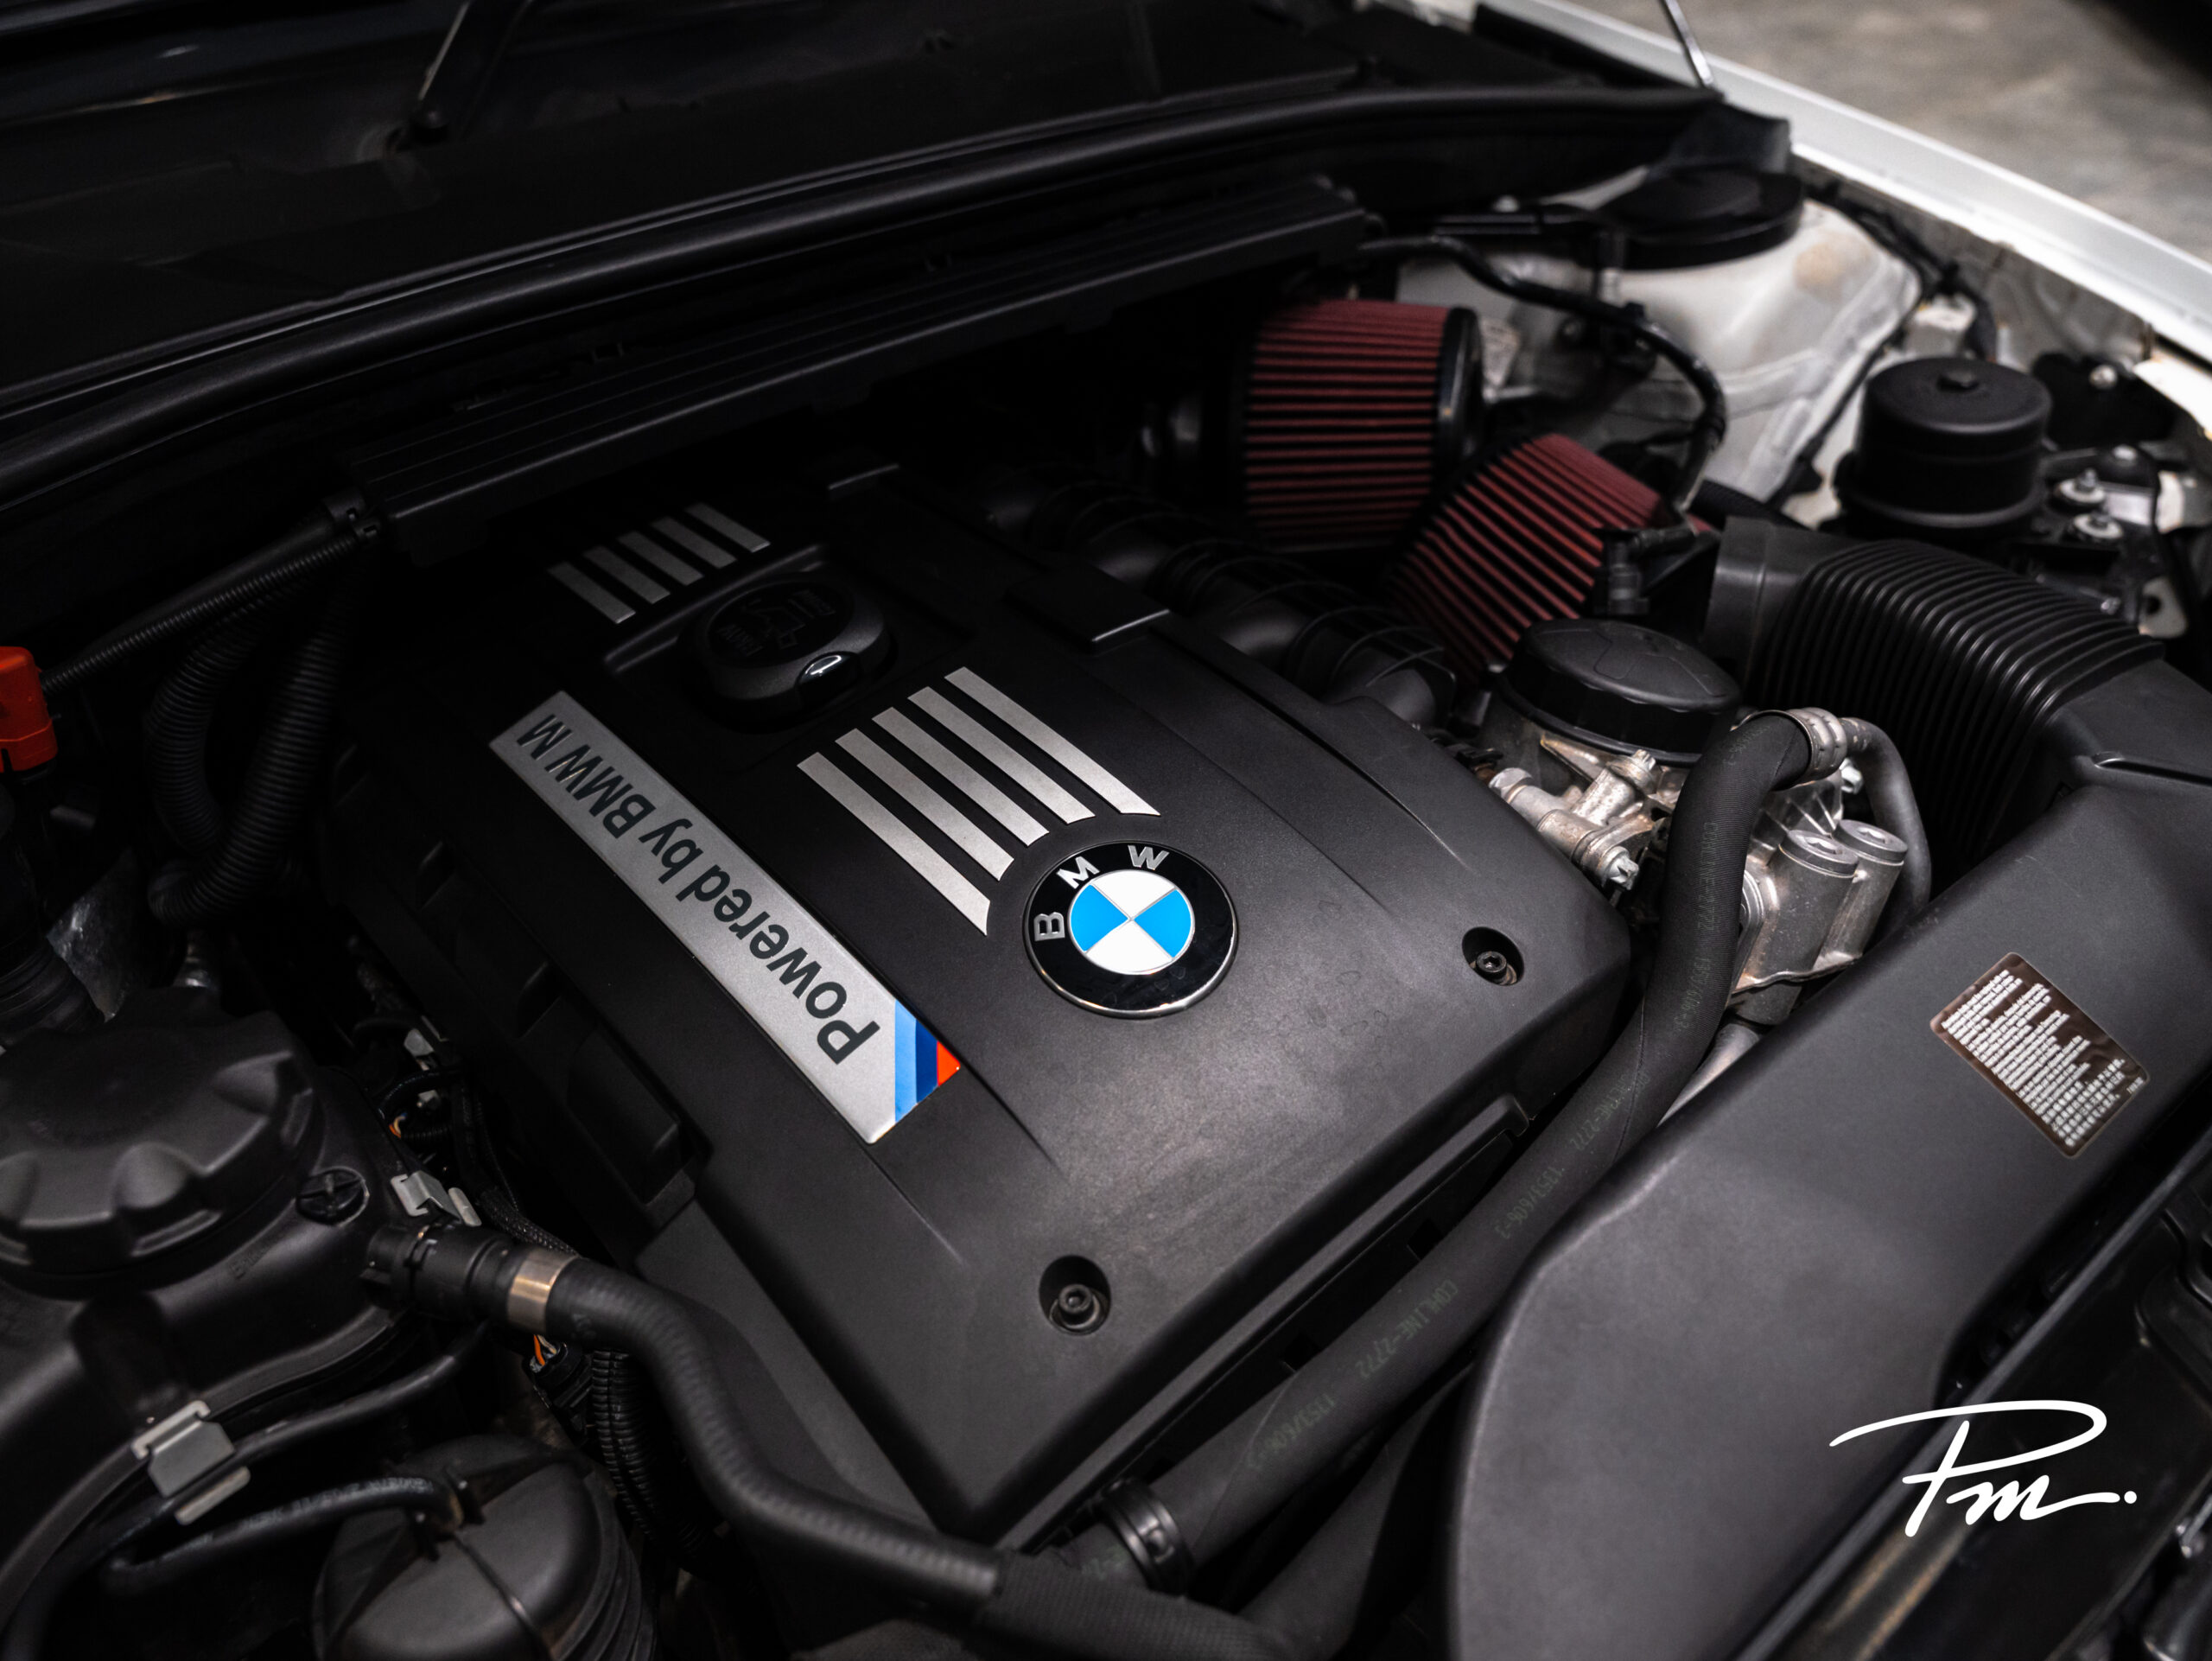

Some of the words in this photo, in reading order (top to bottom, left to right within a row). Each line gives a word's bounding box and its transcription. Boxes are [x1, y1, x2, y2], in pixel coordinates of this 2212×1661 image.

[517, 714, 567, 760] M
[549, 744, 657, 839] BMW
[639, 818, 703, 884] by
[1033, 844, 1169, 942] BMW
[675, 864, 880, 1066] Powered
